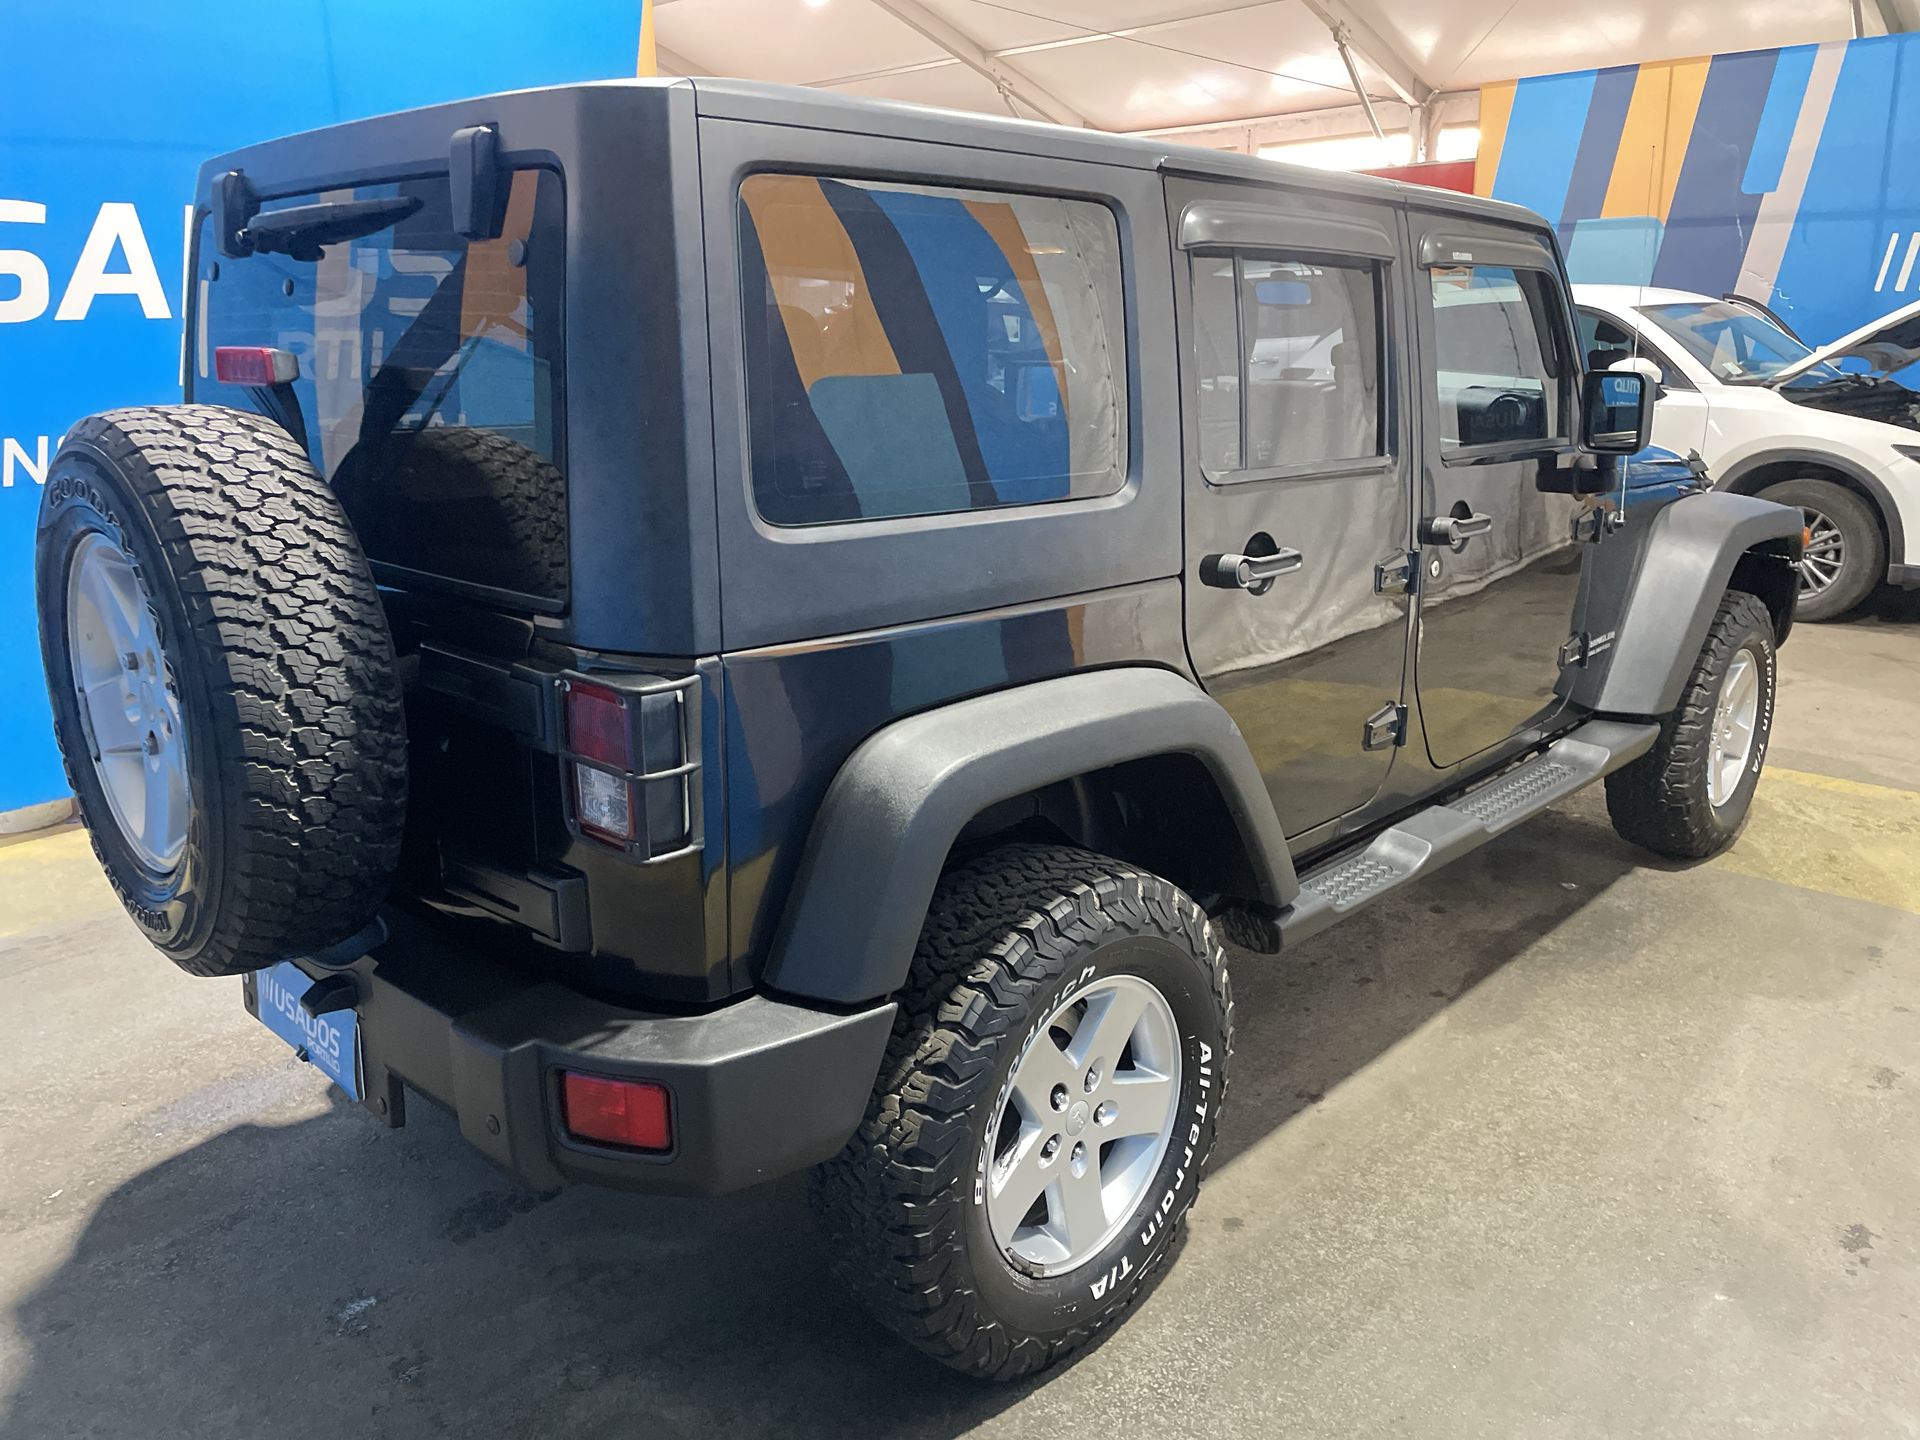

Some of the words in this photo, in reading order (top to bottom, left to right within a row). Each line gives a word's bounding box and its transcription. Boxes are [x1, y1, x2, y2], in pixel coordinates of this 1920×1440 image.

[0, 199, 192, 323] SA
[1140, 1041, 1212, 1246] All-Terrain
[1089, 1256, 1133, 1300] T/A
